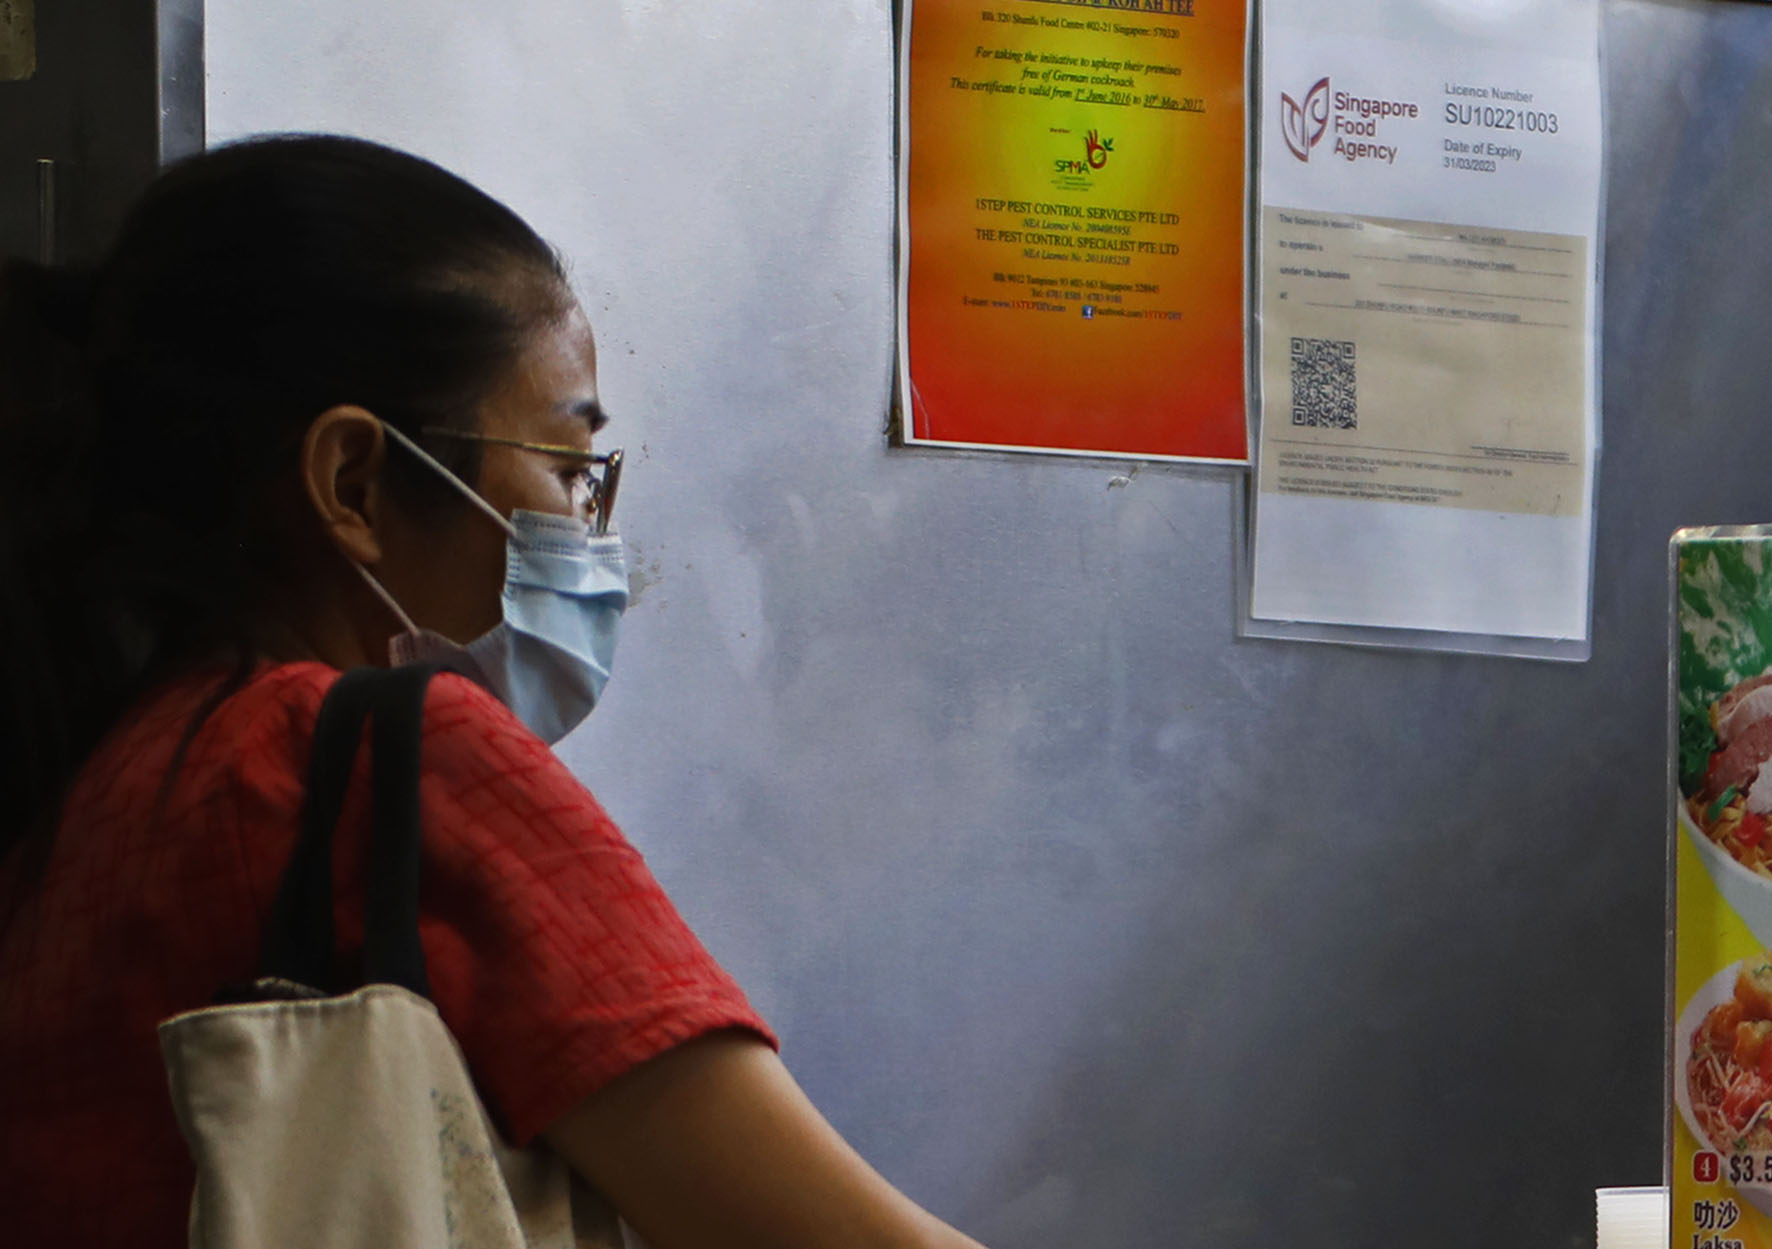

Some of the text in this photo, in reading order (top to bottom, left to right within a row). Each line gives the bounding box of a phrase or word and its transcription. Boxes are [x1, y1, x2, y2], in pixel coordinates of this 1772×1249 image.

[1168, 0, 1194, 14] TEE
[1041, 17, 1059, 27] Food
[975, 46, 1182, 76] For taking the initiative to upkeep their premises
[1021, 67, 1038, 81] free
[1041, 69, 1053, 82] of
[1053, 70, 1089, 82] German
[951, 77, 969, 88] This
[971, 80, 1016, 94] certificate
[1018, 84, 1026, 94] is
[1029, 85, 1052, 97] valid
[1049, 87, 1073, 100] from
[1445, 83, 1534, 103] Licence Number
[1334, 91, 1419, 120] Singapore
[1334, 116, 1376, 137] Food
[1445, 103, 1559, 133] SU10221003
[1334, 138, 1398, 165] Agency
[1445, 139, 1522, 162] Date of Expiry
[1055, 160, 1090, 174] SPMA
[1444, 156, 1497, 173] 31/03/2023
[976, 198, 1180, 225] 1STEP PEST CONTROL SERVICES PTE LTD
[976, 228, 1180, 256] THE PEST CONTROL SPECIALIST PTE LTD
[1693, 1200, 1739, 1230] 叻沙
